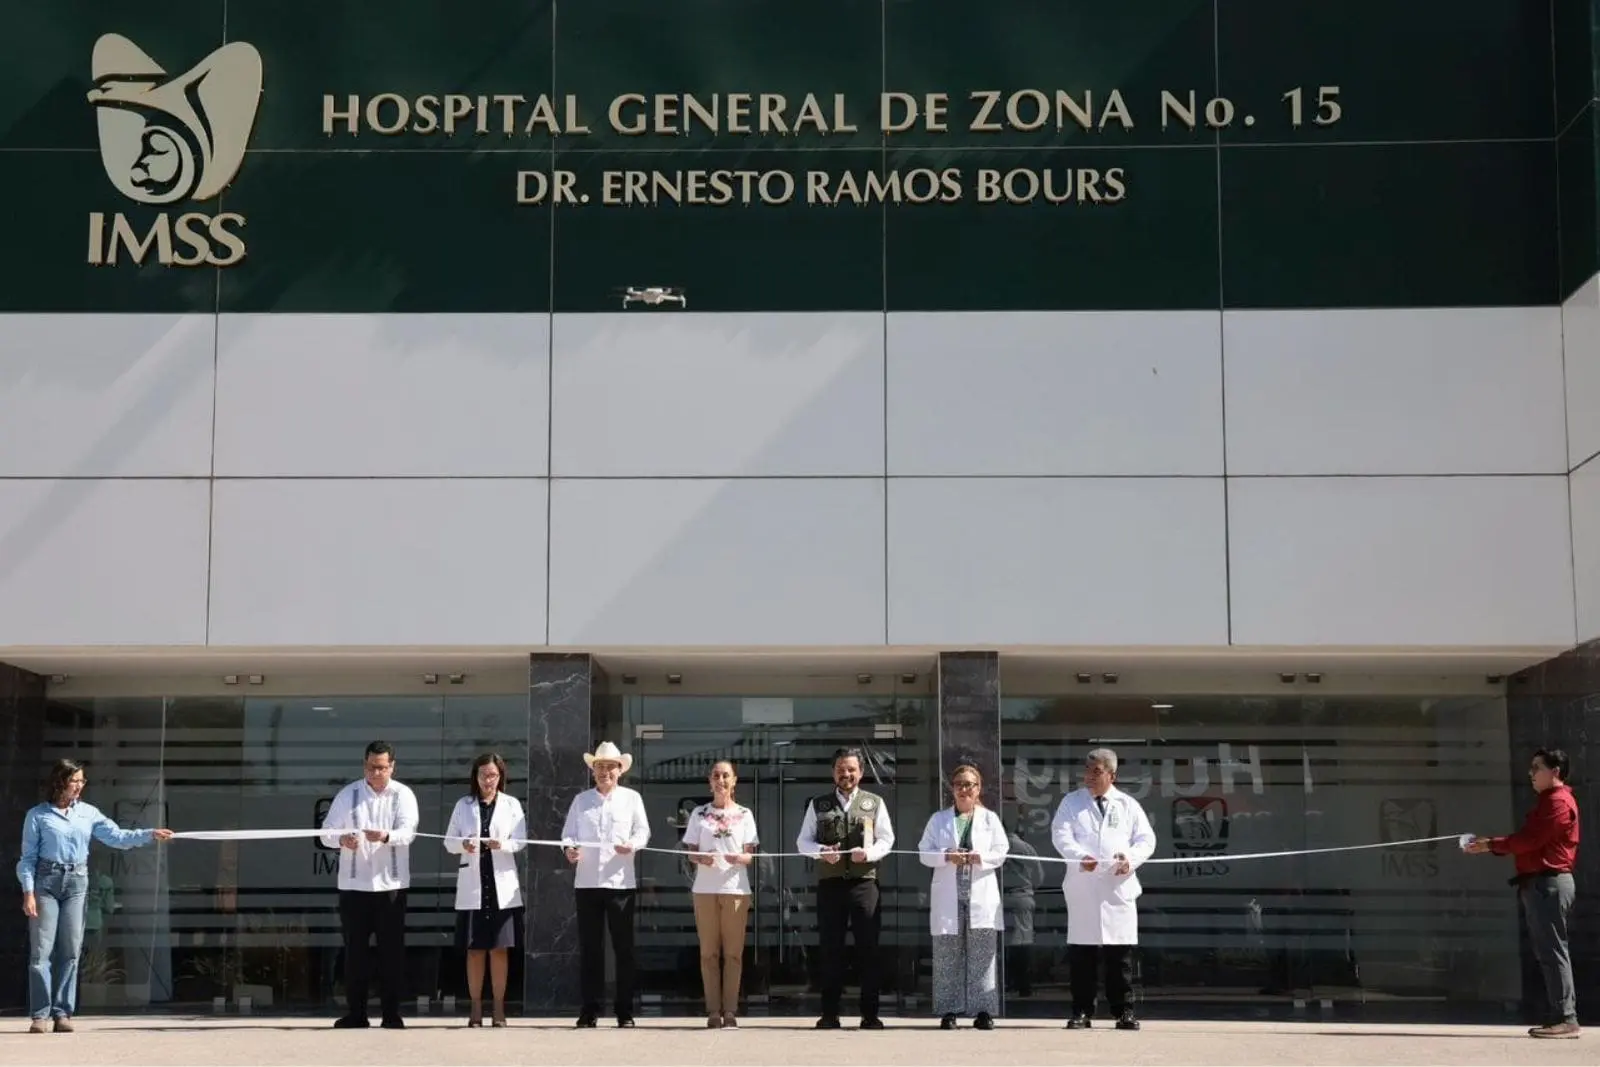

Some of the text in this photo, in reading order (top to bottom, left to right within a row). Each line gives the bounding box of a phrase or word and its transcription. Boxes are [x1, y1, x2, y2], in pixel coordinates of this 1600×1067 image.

[322, 86, 1342, 135] HOSPITAL GENERAL DE ZONA No. 15
[516, 167, 1127, 204] DR. ERNESTO RAMOS BOURS
[87, 212, 247, 267] IMSS
[1380, 852, 1440, 878] IMSS
